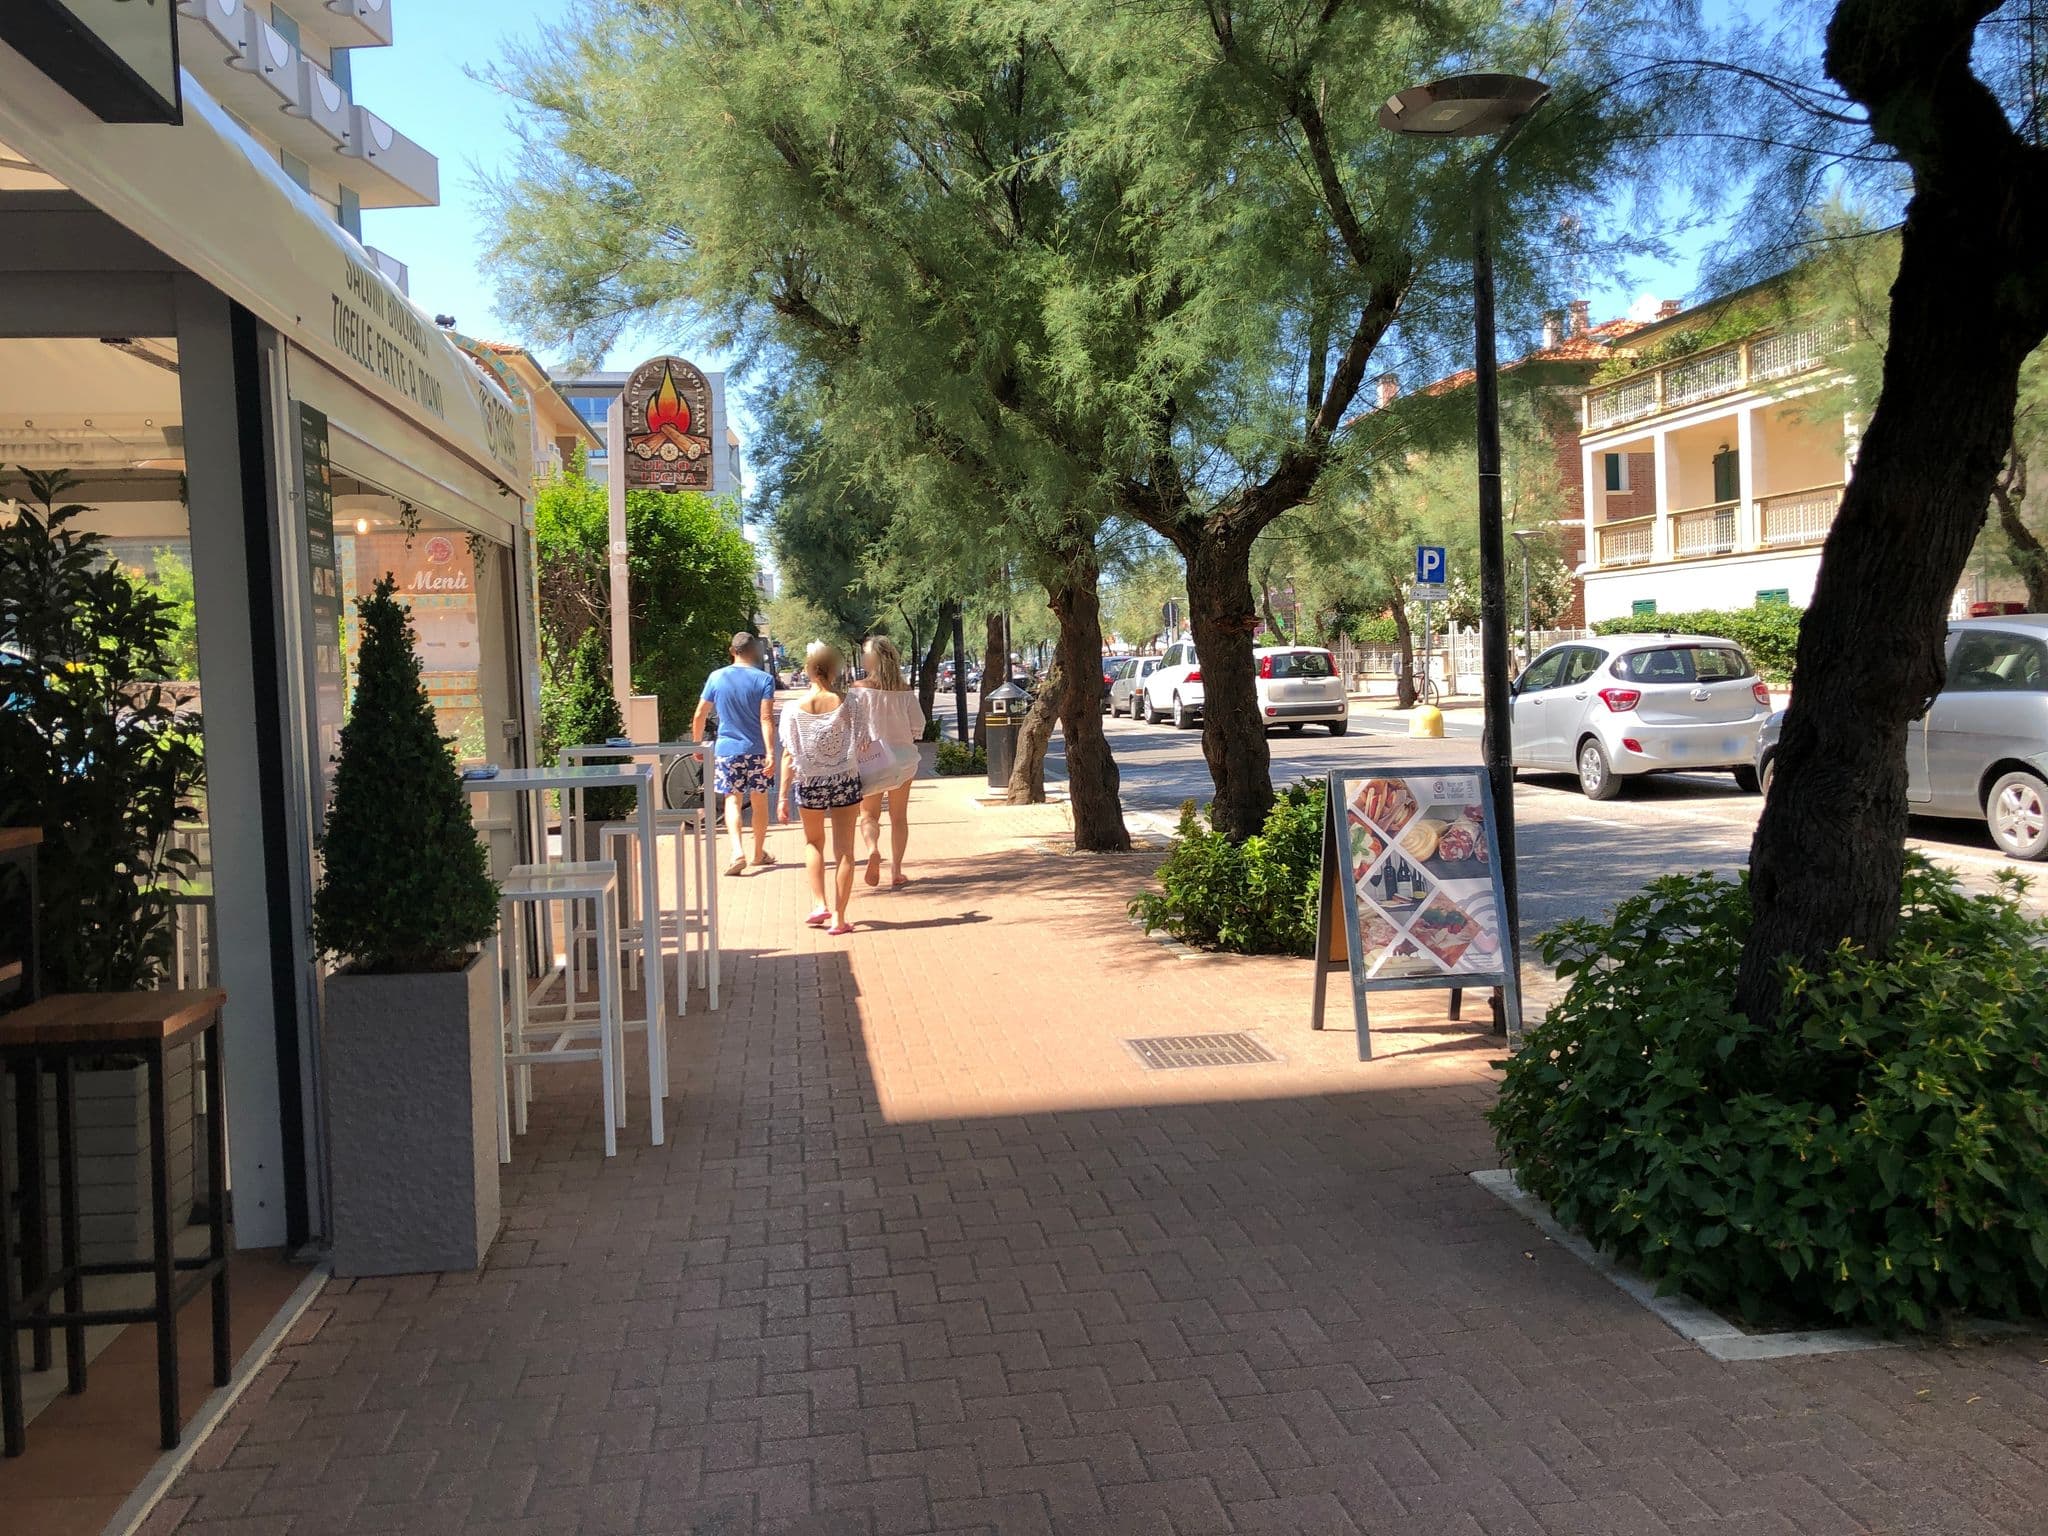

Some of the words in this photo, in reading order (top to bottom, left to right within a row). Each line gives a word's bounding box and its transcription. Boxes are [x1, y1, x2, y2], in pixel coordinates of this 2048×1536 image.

[345, 254, 384, 320] SALUMI
[331, 292, 374, 372] TIGELLE
[377, 332, 408, 396] FATTE
[408, 359, 418, 402] A
[418, 366, 444, 421] MANO
[631, 364, 660, 396] PIZZA
[631, 400, 640, 433] VERA
[631, 459, 690, 472] FORNO
[692, 460, 705, 472] A
[640, 471, 698, 484] LEGNA
[1422, 549, 1440, 580] P
